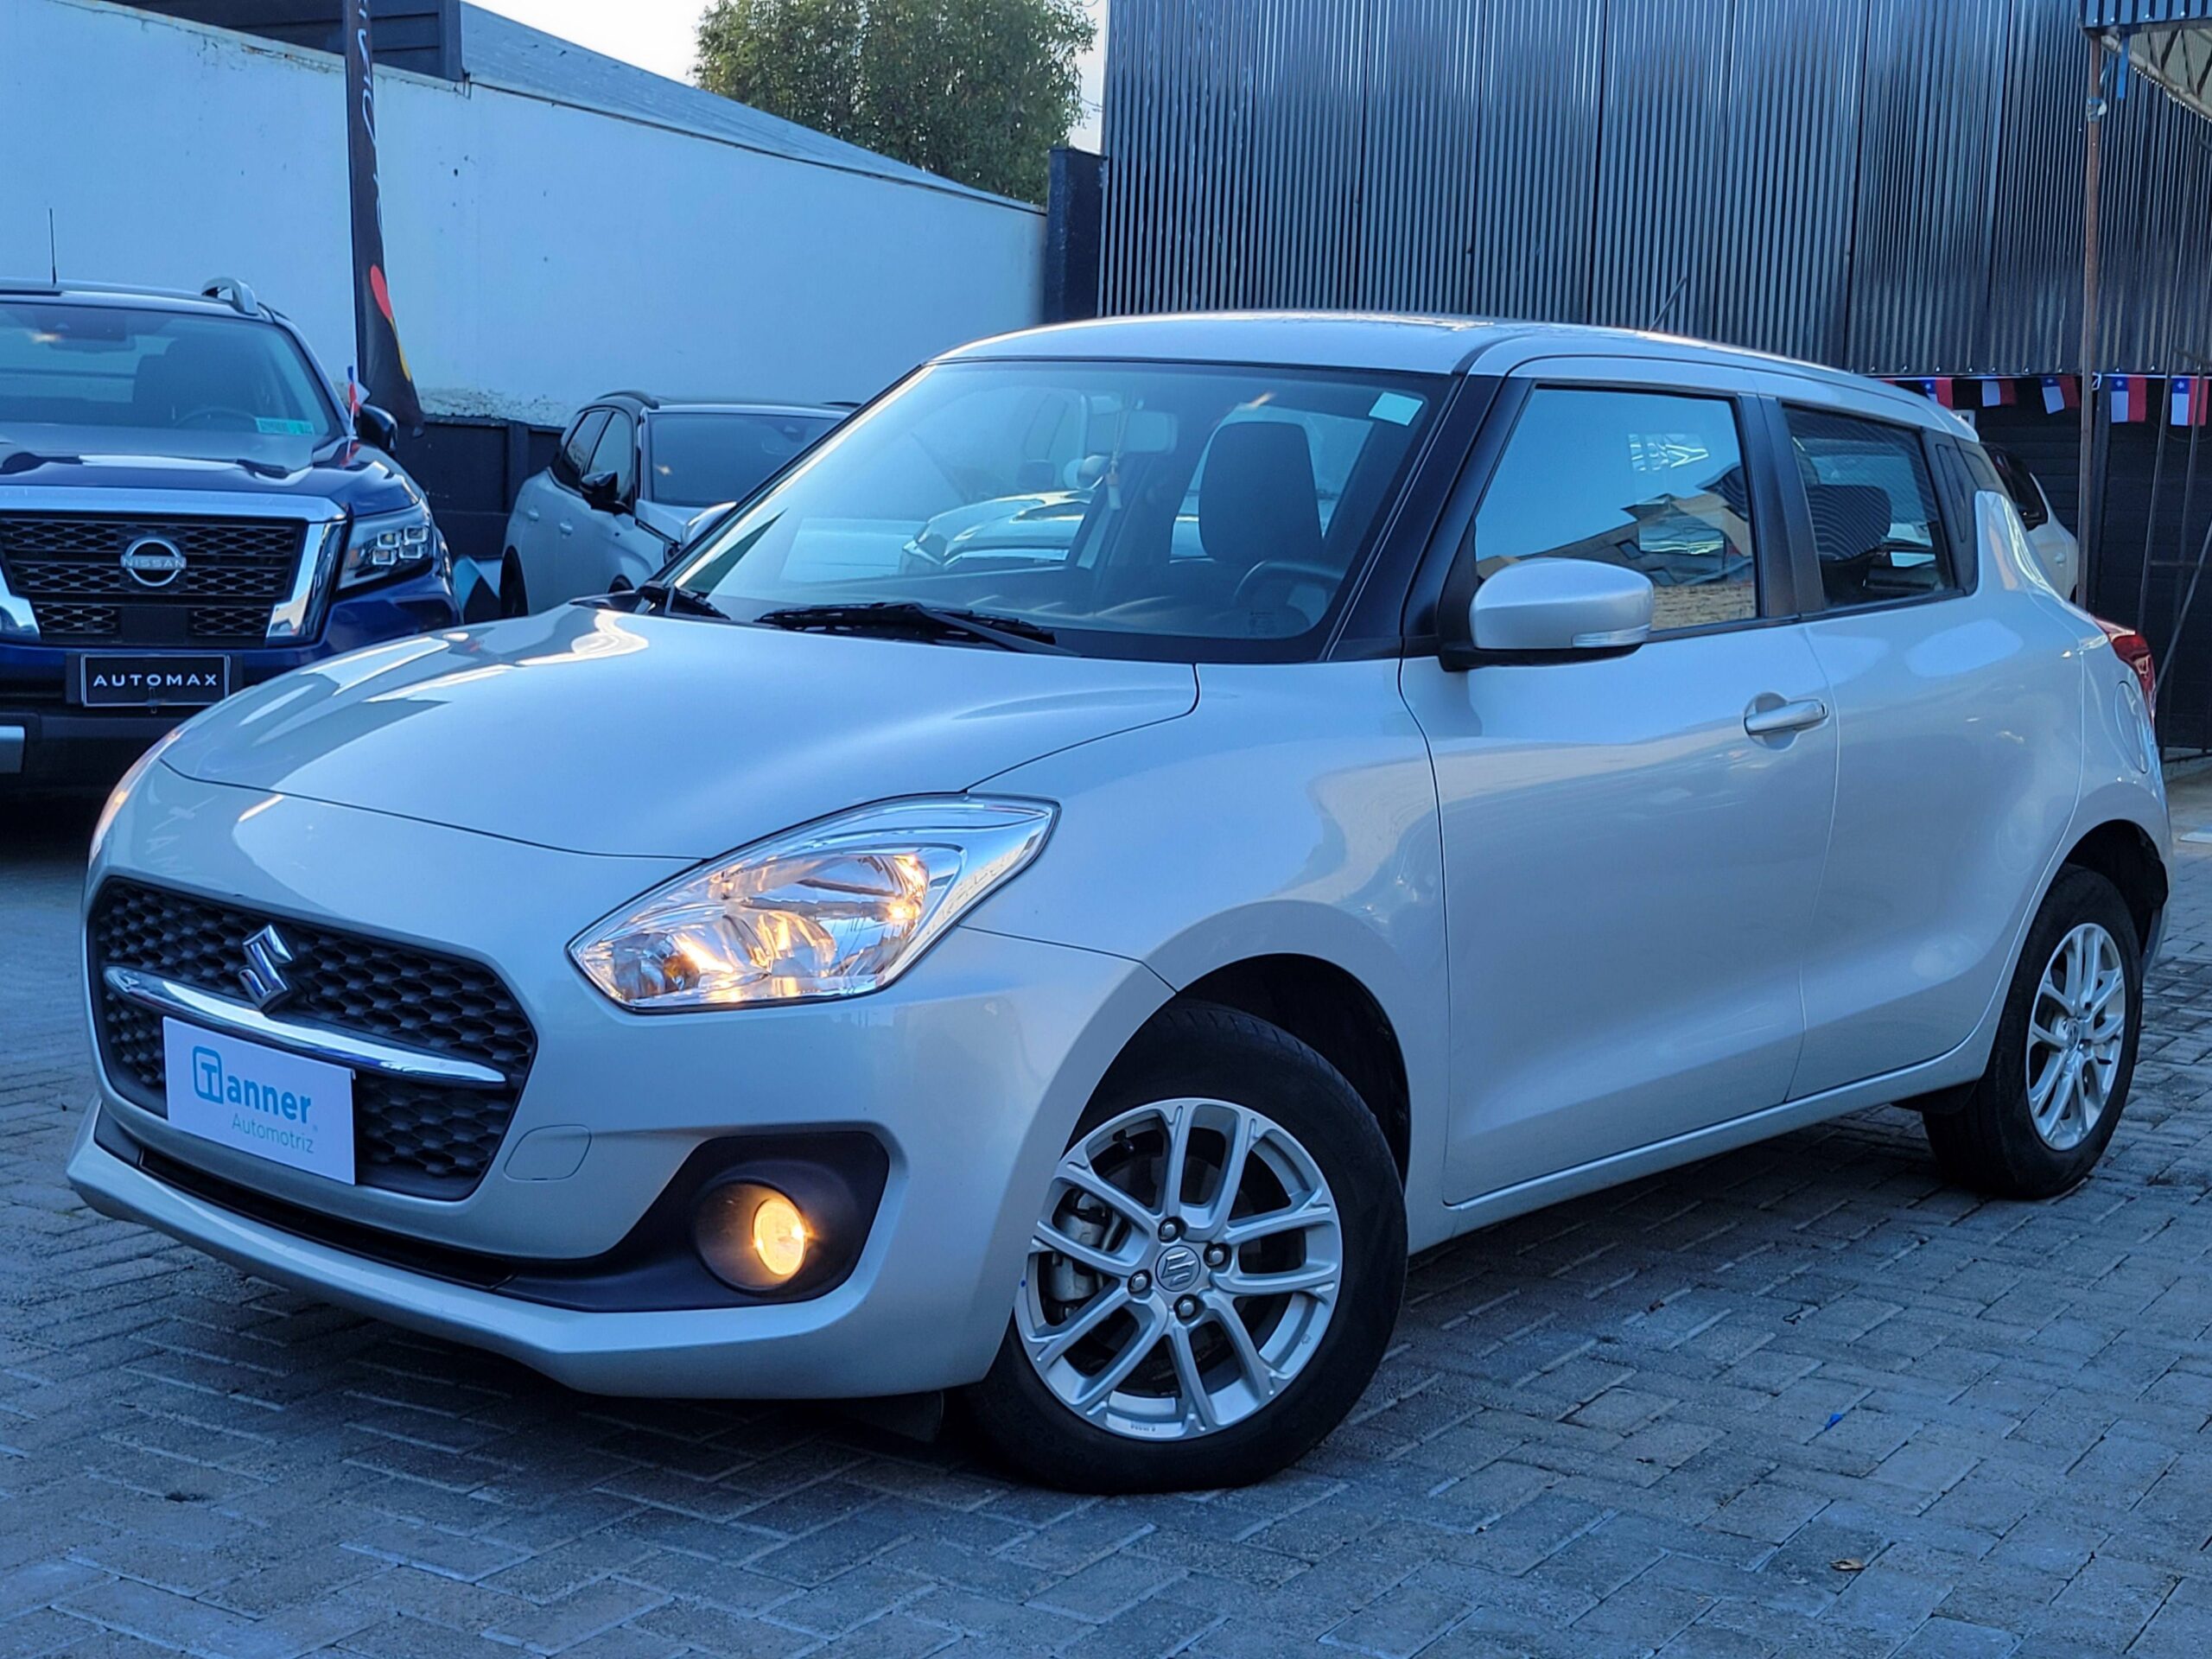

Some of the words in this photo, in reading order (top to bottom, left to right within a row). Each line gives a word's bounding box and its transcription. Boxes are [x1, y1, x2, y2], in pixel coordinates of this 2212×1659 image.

[124, 557, 185, 568] NISSAN
[93, 673, 217, 687] AUTOMAX
[192, 1045, 312, 1124] Tanner
[231, 1112, 315, 1154] Automotriz
